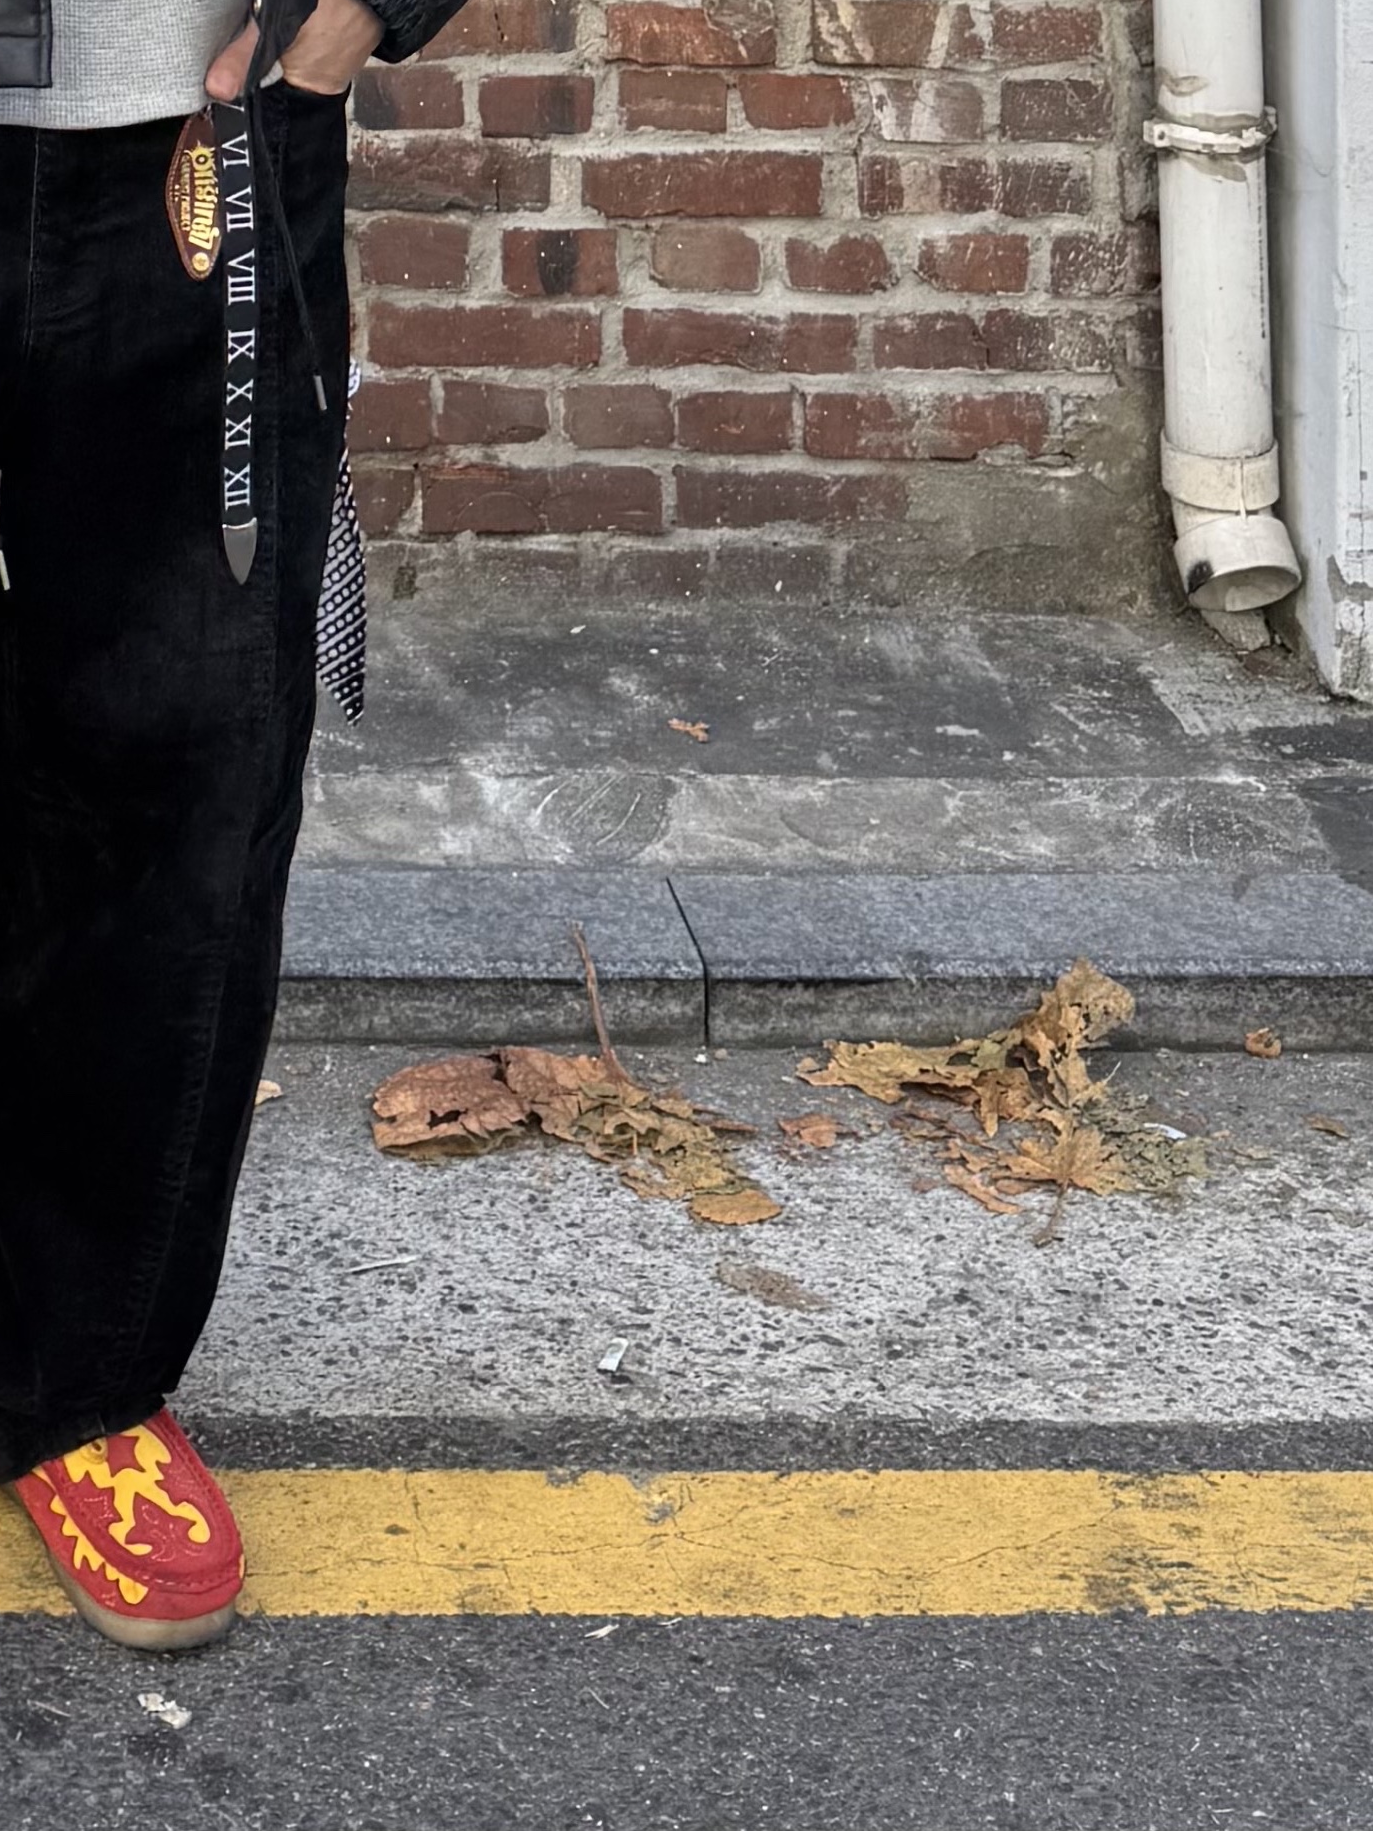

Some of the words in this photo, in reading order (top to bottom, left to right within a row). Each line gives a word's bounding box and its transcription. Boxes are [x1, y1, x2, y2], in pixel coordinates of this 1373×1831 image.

[221, 131, 250, 169] VI
[225, 183, 254, 232] VII
[227, 248, 256, 305] VIII
[227, 328, 256, 364] IX
[227, 378, 254, 405] X
[224, 413, 252, 450] XI
[224, 463, 251, 510] XII
